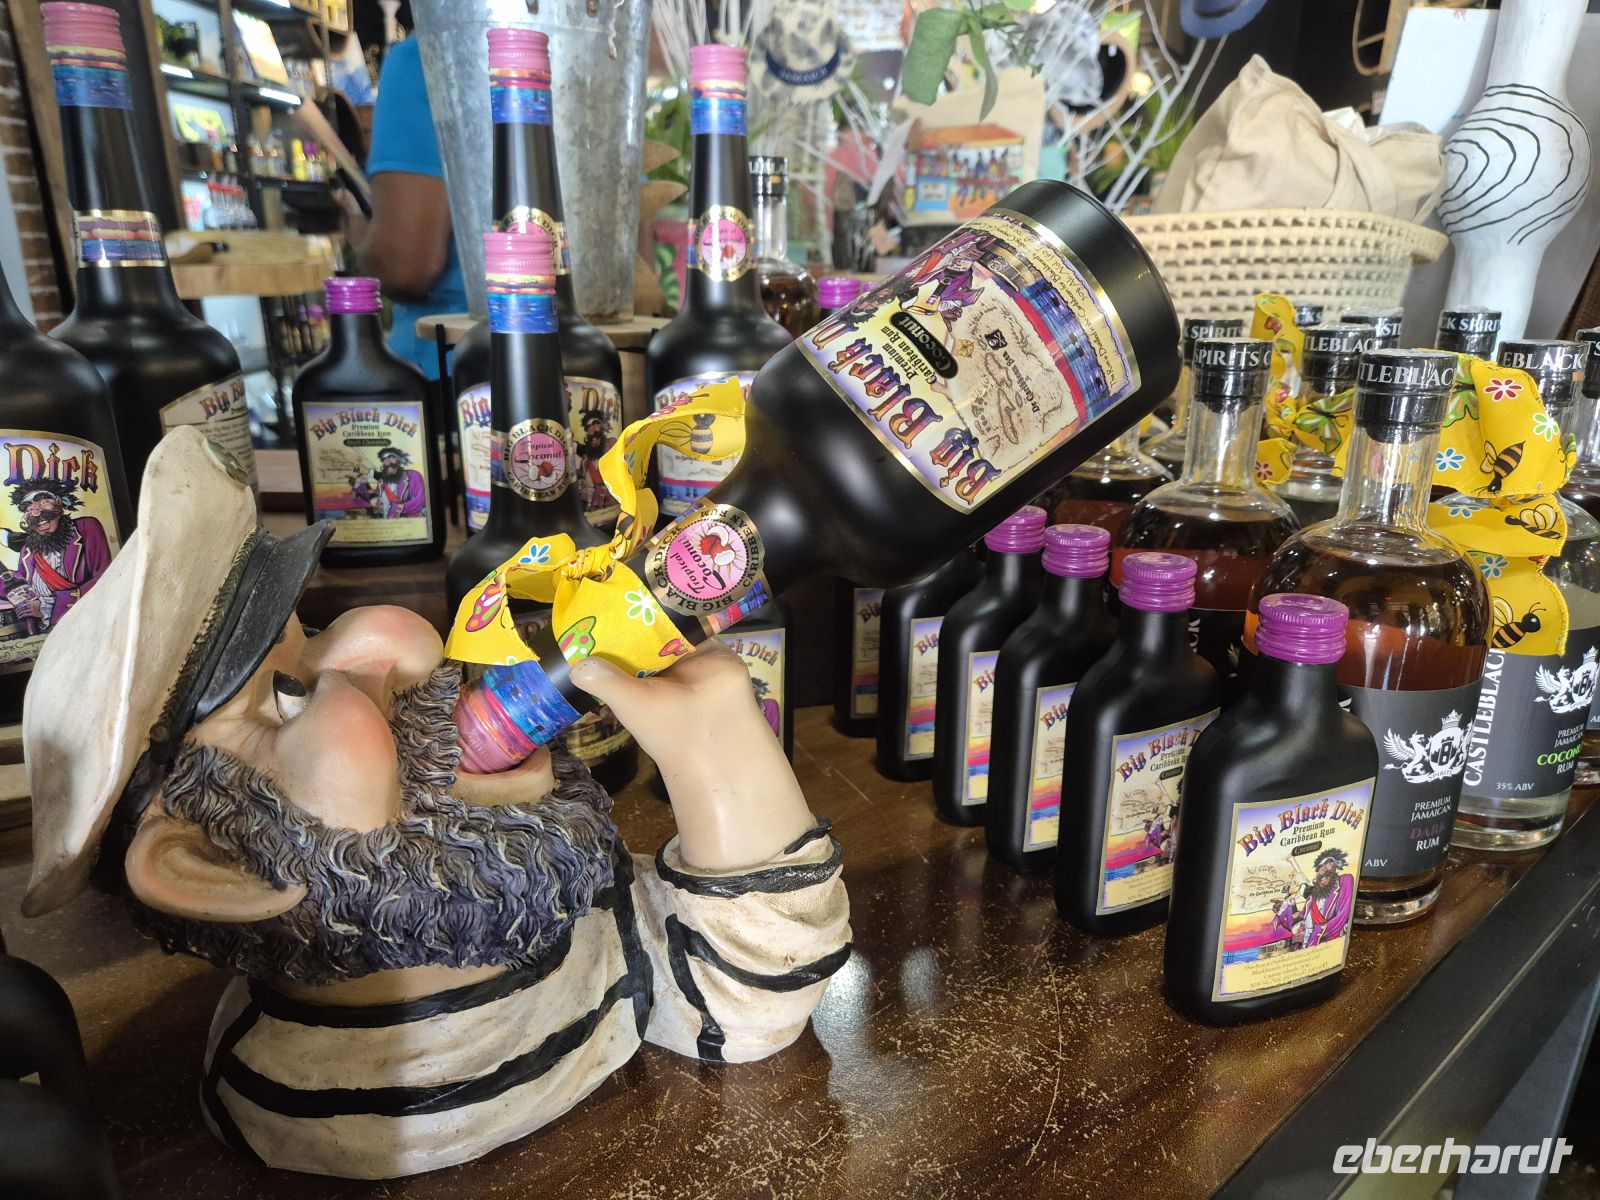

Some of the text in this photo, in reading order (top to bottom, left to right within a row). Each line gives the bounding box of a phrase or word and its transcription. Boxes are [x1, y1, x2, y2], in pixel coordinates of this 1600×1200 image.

[880, 325, 938, 385] Caribbean Rum
[882, 342, 919, 381] Premium
[898, 315, 951, 371] Coconut
[827, 337, 944, 450] Black
[1011, 364, 1035, 402] Caribbean
[310, 407, 418, 441] Big Black Dick
[3, 442, 99, 494] Dick
[930, 426, 1002, 506] Big
[678, 535, 727, 591] Coconut
[729, 513, 761, 588] CARIBBEAN
[653, 565, 699, 612] BLACK
[669, 551, 705, 595] Tropical
[701, 594, 734, 612] BIG
[1116, 750, 1147, 783] Big
[1147, 727, 1189, 760] Black
[1150, 757, 1181, 772] Caribbean
[1160, 747, 1186, 761] Premium
[1414, 795, 1452, 812] PREMIUM
[1514, 782, 1535, 791] ABV
[1237, 797, 1365, 858] Big Black Dick
[1292, 820, 1326, 836] Premium
[1410, 803, 1452, 822] JAMAICAN
[1279, 826, 1336, 848] Caribbean Rum
[1416, 836, 1440, 851] RUM
[1364, 859, 1389, 868] ABV
